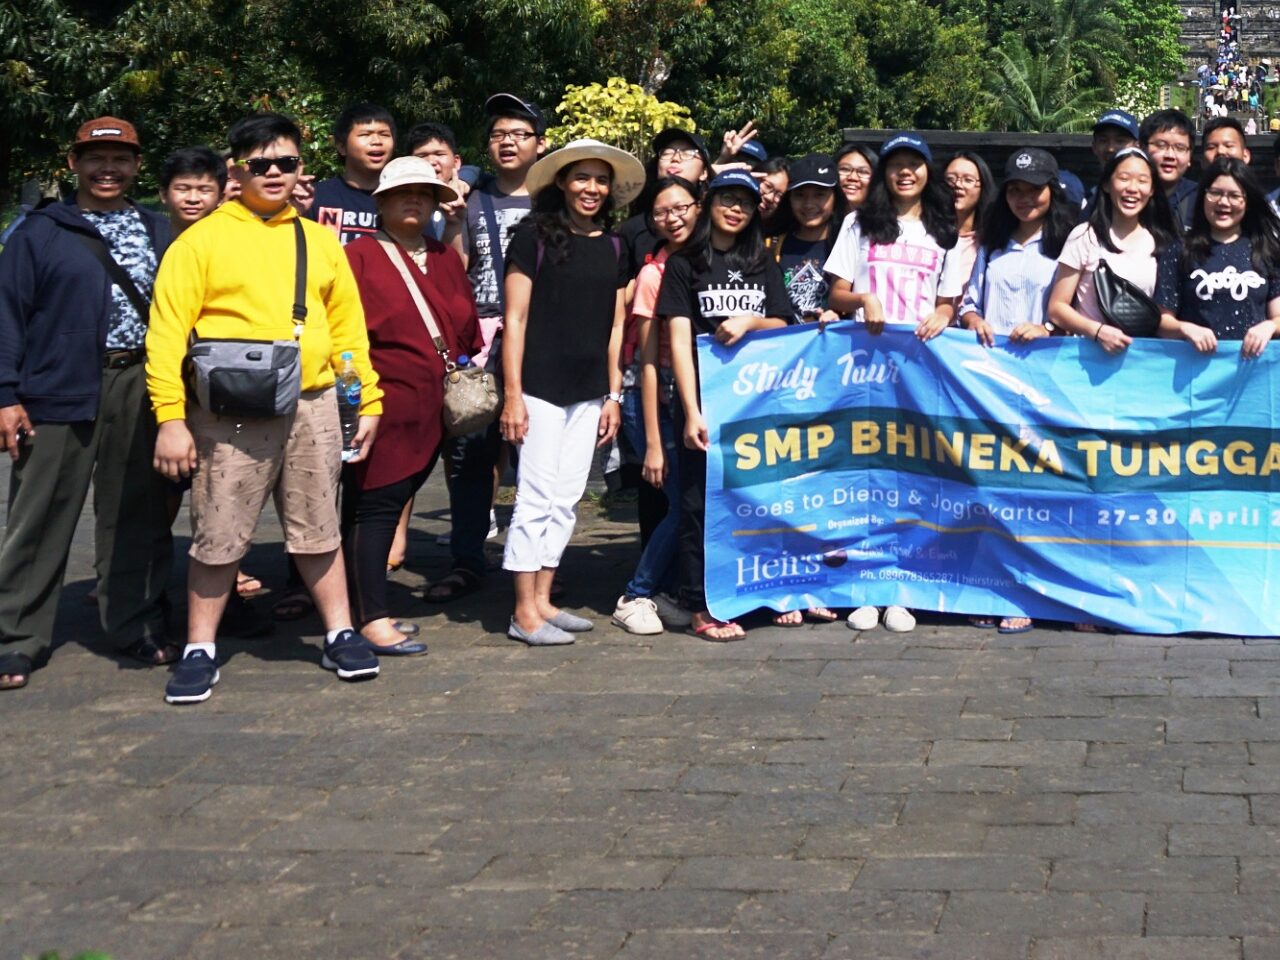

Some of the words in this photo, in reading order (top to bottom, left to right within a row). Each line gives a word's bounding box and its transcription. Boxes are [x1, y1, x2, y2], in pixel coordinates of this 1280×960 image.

[701, 294, 765, 313] DJOGJA
[732, 358, 819, 401] Study
[837, 349, 900, 387] Tour
[734, 424, 835, 470] SMP
[851, 420, 1064, 474] BHINEKA
[736, 499, 794, 518] Goes
[802, 494, 824, 510] to
[833, 486, 900, 508] Dieng
[908, 490, 922, 506] &
[930, 493, 1050, 521] Jogjakarta
[1098, 507, 1177, 527] 27-30
[1188, 507, 1260, 530] April
[828, 515, 870, 530] Organized
